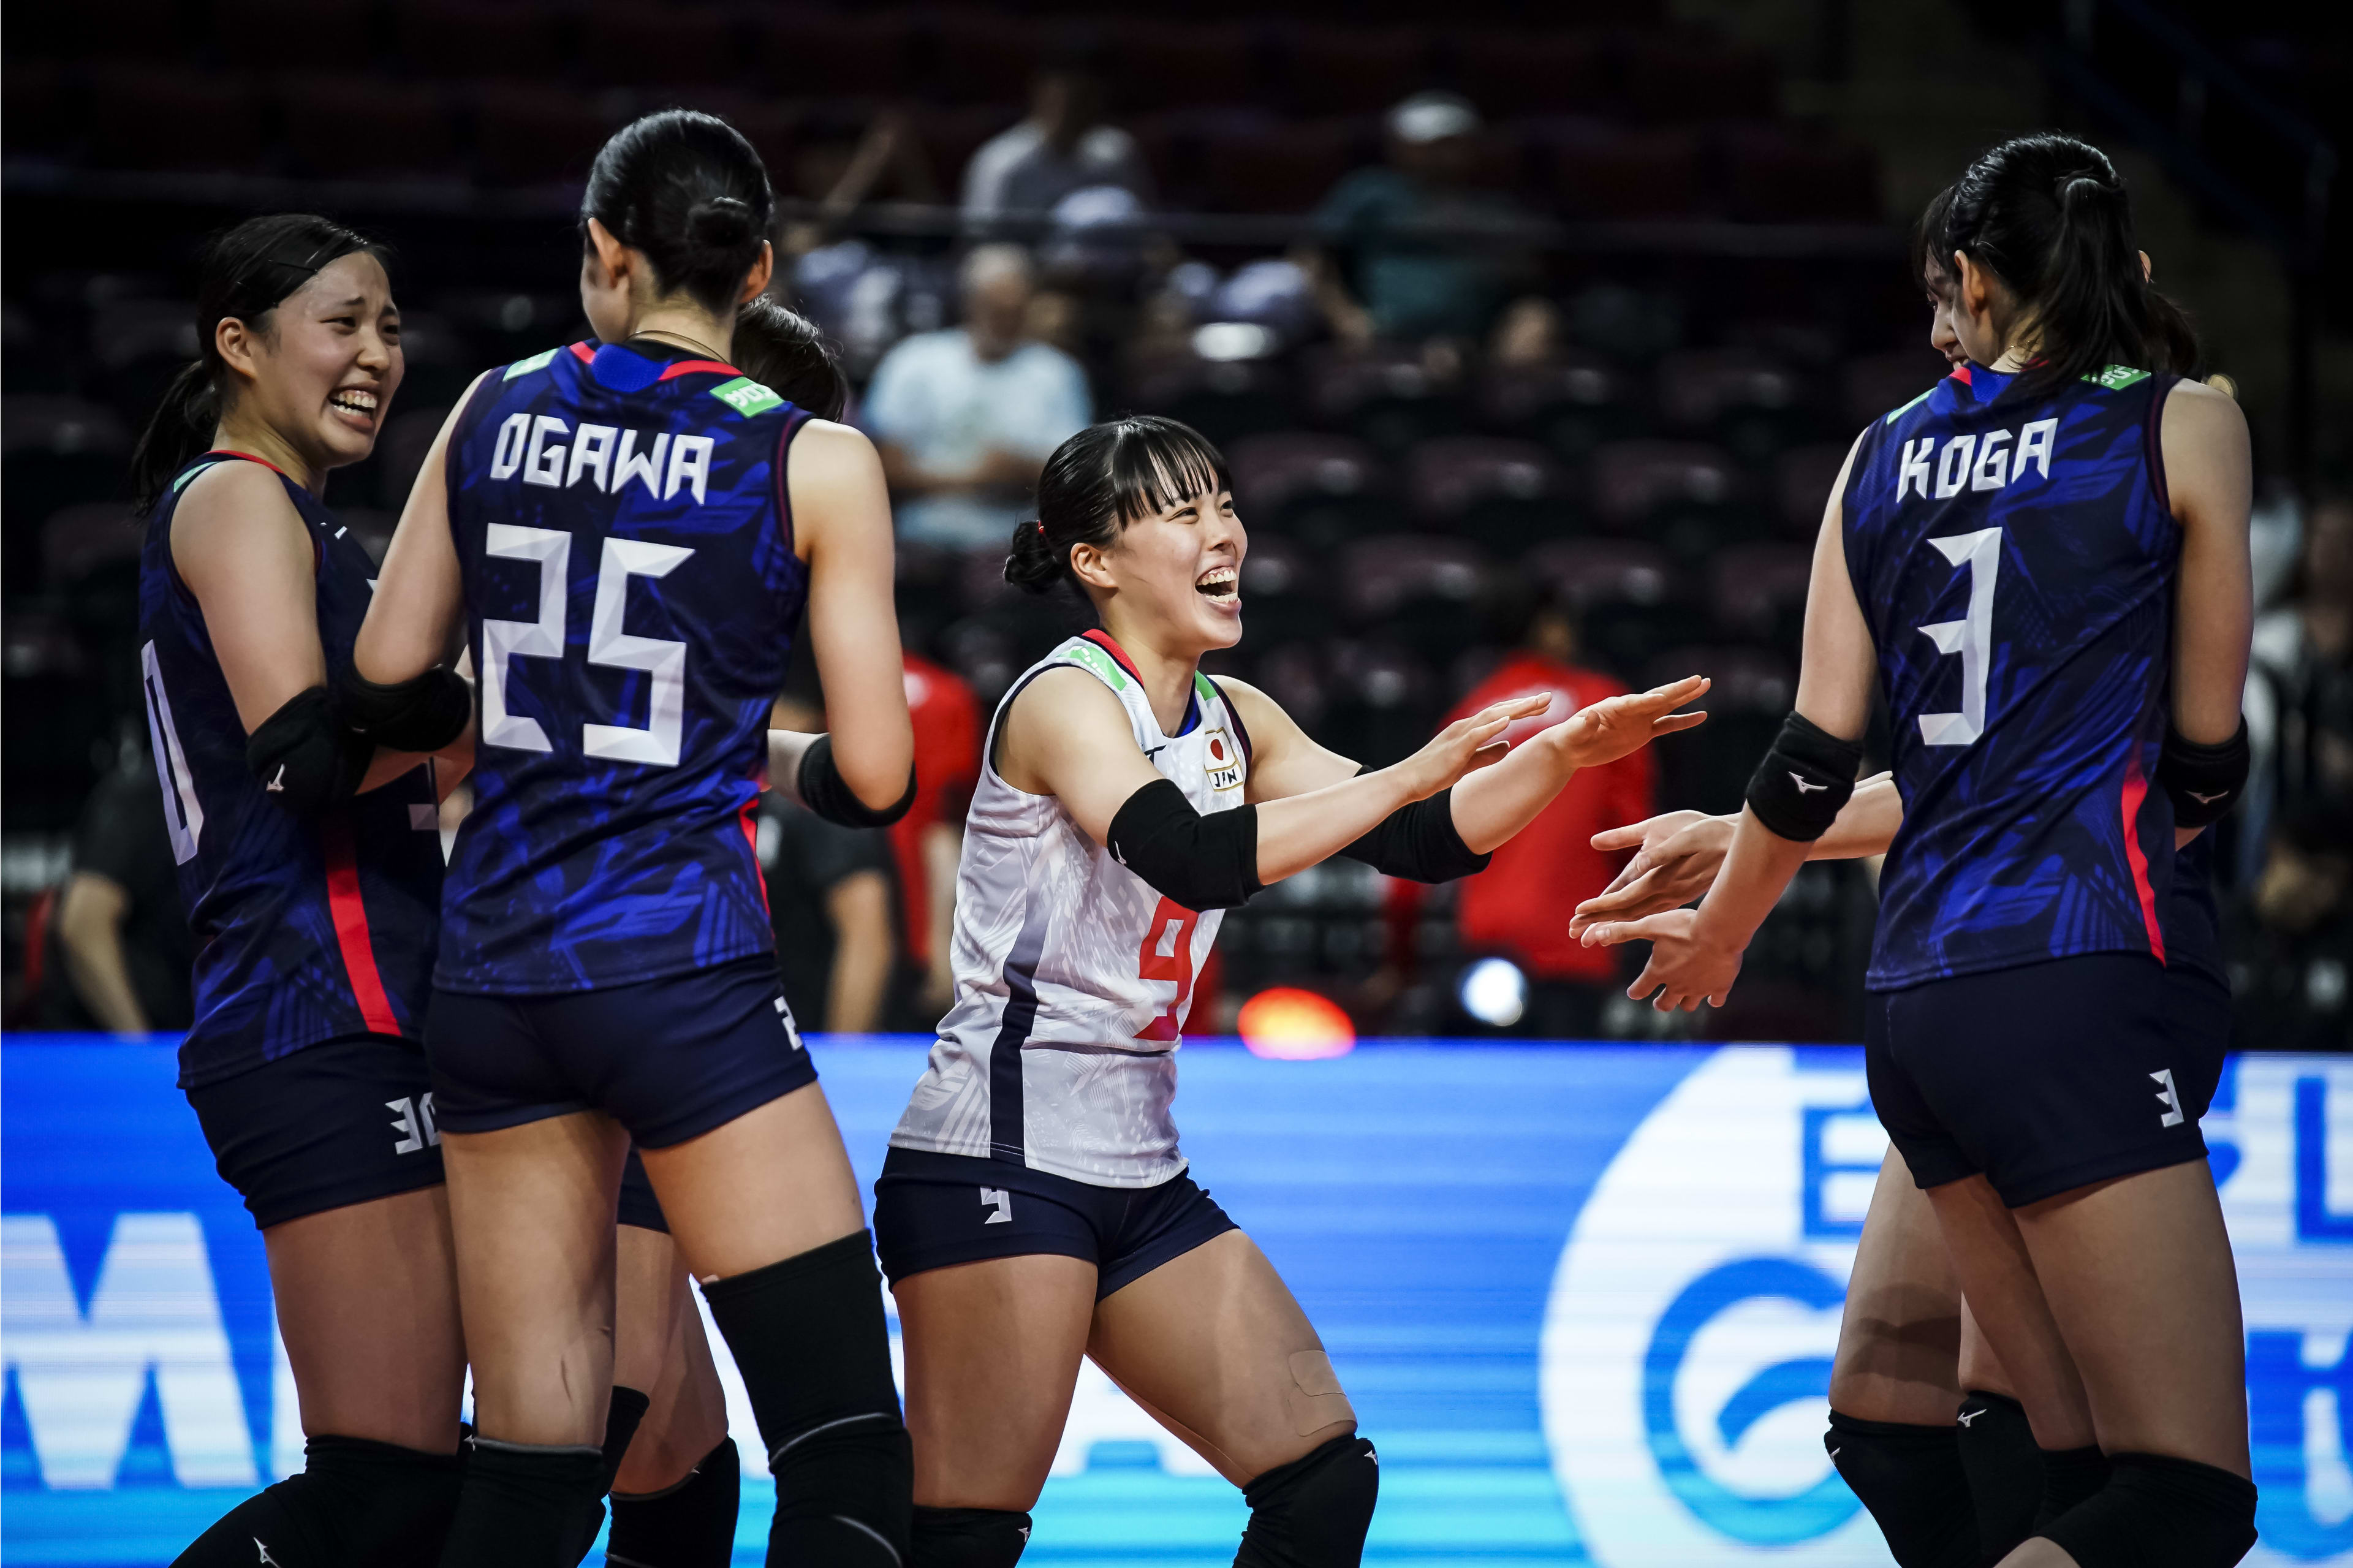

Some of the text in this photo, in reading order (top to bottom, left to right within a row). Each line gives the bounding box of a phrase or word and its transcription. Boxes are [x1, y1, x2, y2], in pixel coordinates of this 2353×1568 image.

[490, 412, 714, 506] OGAWA
[1896, 417, 2058, 503] KOGA
[482, 523, 695, 767] 25
[1917, 526, 2003, 746] 3
[1132, 895, 1199, 1041] 9
[2149, 1068, 2184, 1127] 3
